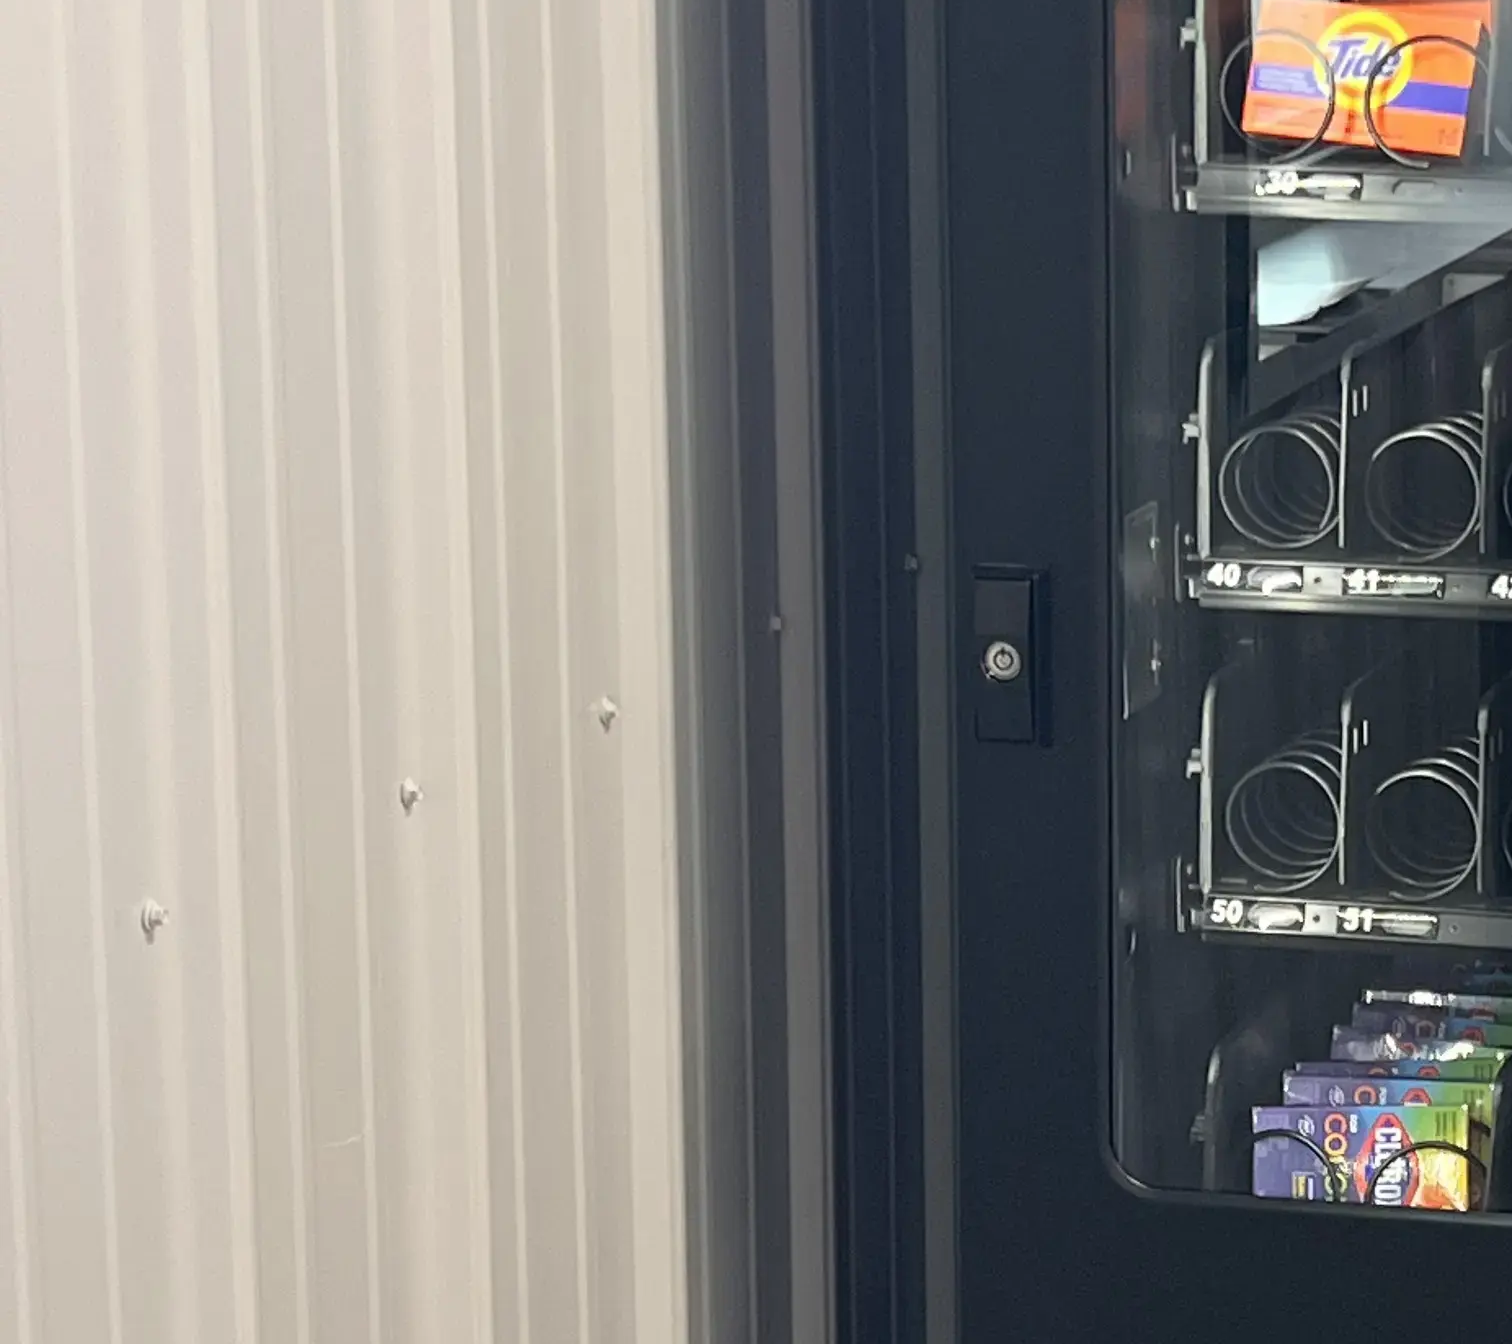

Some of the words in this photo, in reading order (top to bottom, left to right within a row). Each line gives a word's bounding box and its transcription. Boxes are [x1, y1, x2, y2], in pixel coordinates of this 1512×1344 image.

[1327, 38, 1402, 79] Tide
[1206, 562, 1242, 588] 40
[1210, 898, 1244, 925] 50
